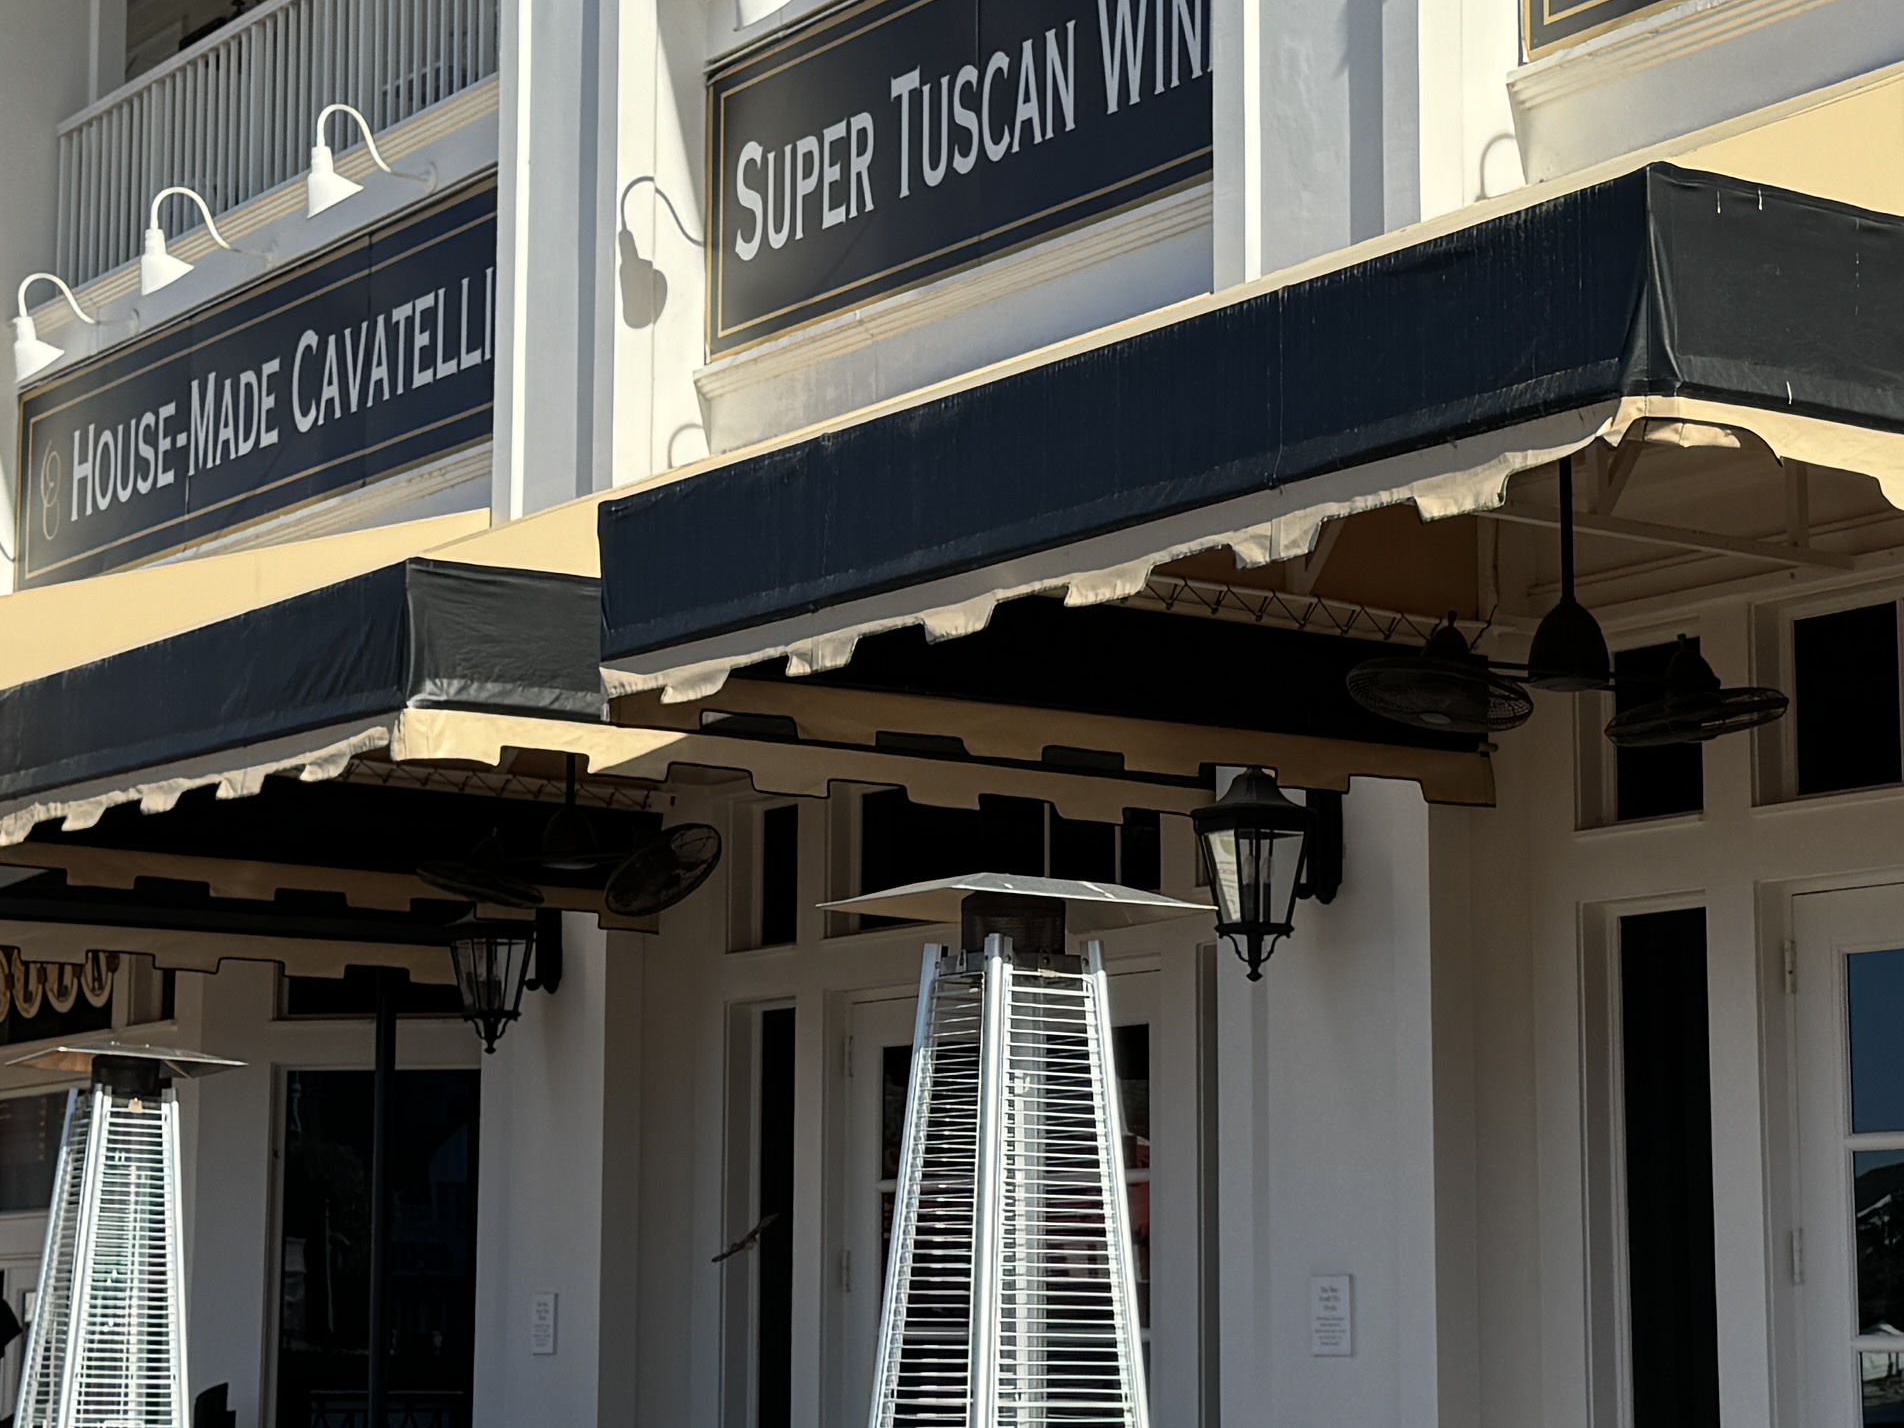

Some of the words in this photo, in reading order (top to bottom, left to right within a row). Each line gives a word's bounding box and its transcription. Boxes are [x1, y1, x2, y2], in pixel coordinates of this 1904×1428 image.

[734, 111, 875, 262] SUPER
[890, 19, 1077, 199] TUSCAN
[70, 356, 281, 522] HOUSE-MADE
[292, 266, 494, 433] CAVATELLI
